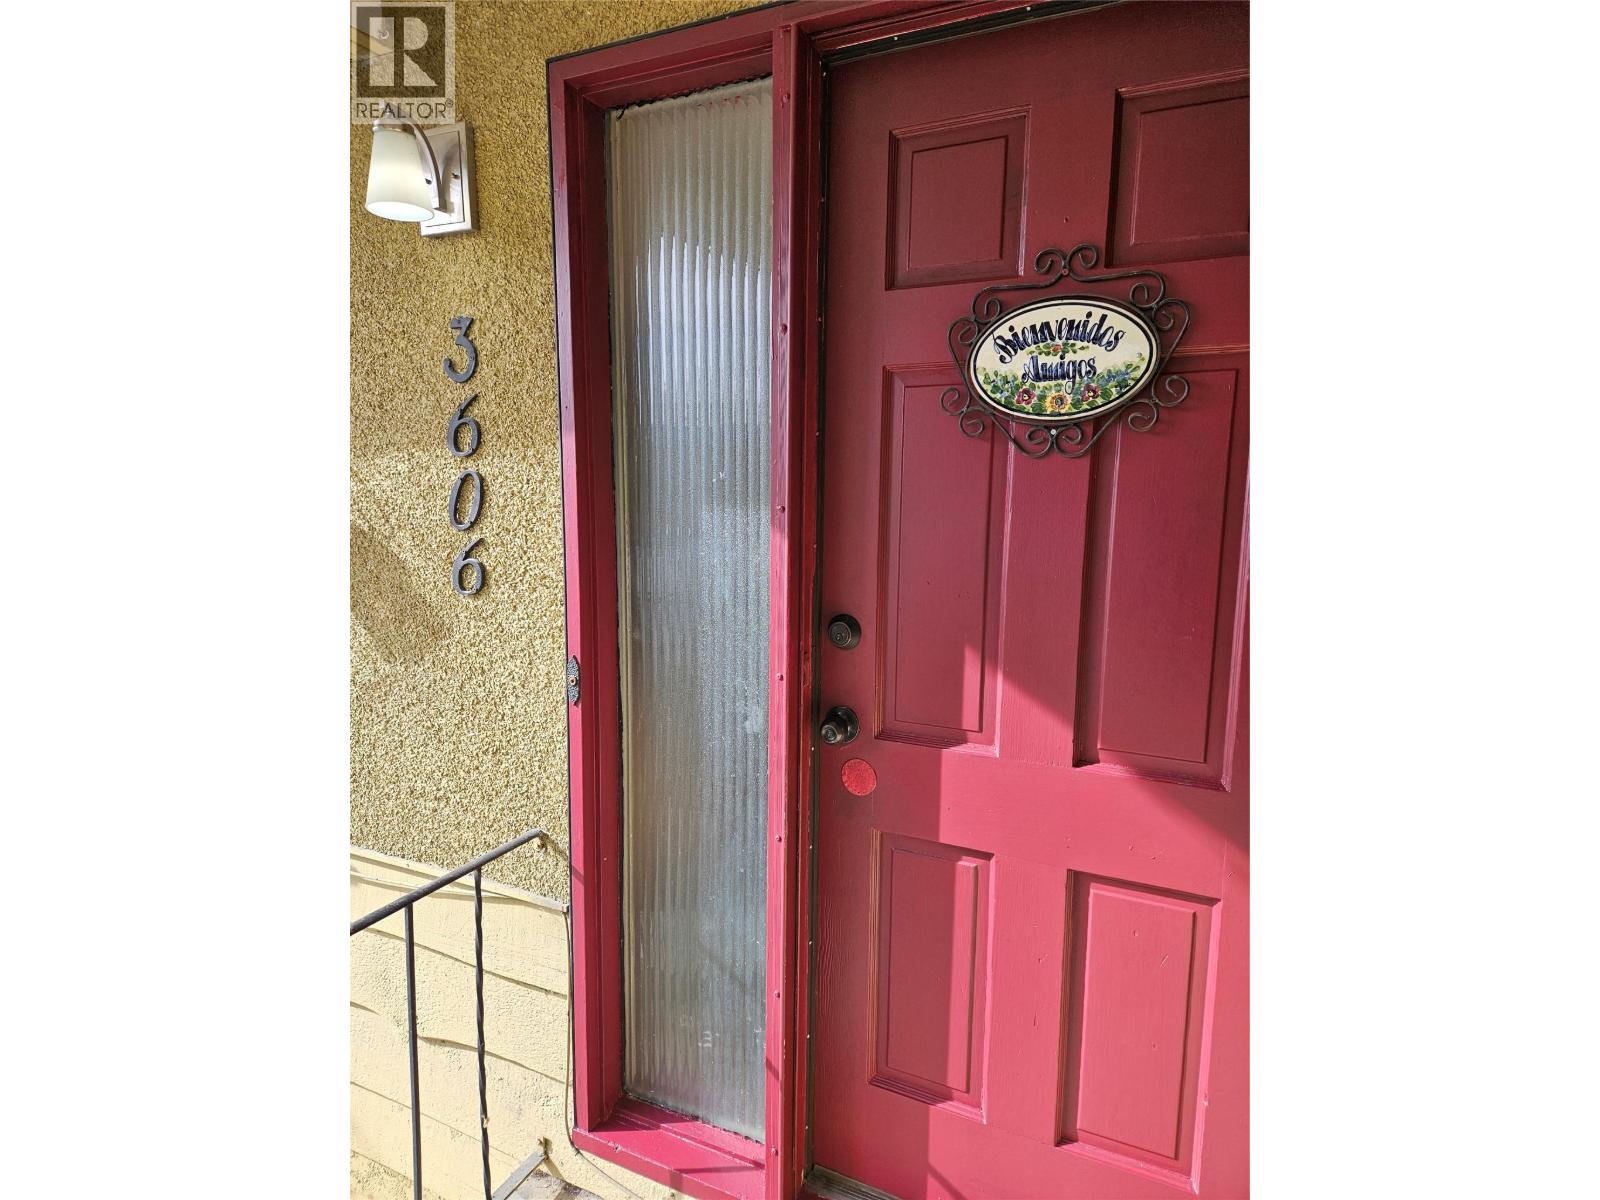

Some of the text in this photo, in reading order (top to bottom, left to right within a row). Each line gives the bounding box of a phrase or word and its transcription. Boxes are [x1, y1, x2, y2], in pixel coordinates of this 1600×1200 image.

[993, 311, 1127, 364] Bienvenidos
[1021, 353, 1097, 395] Amigos
[443, 316, 485, 597] 3606
